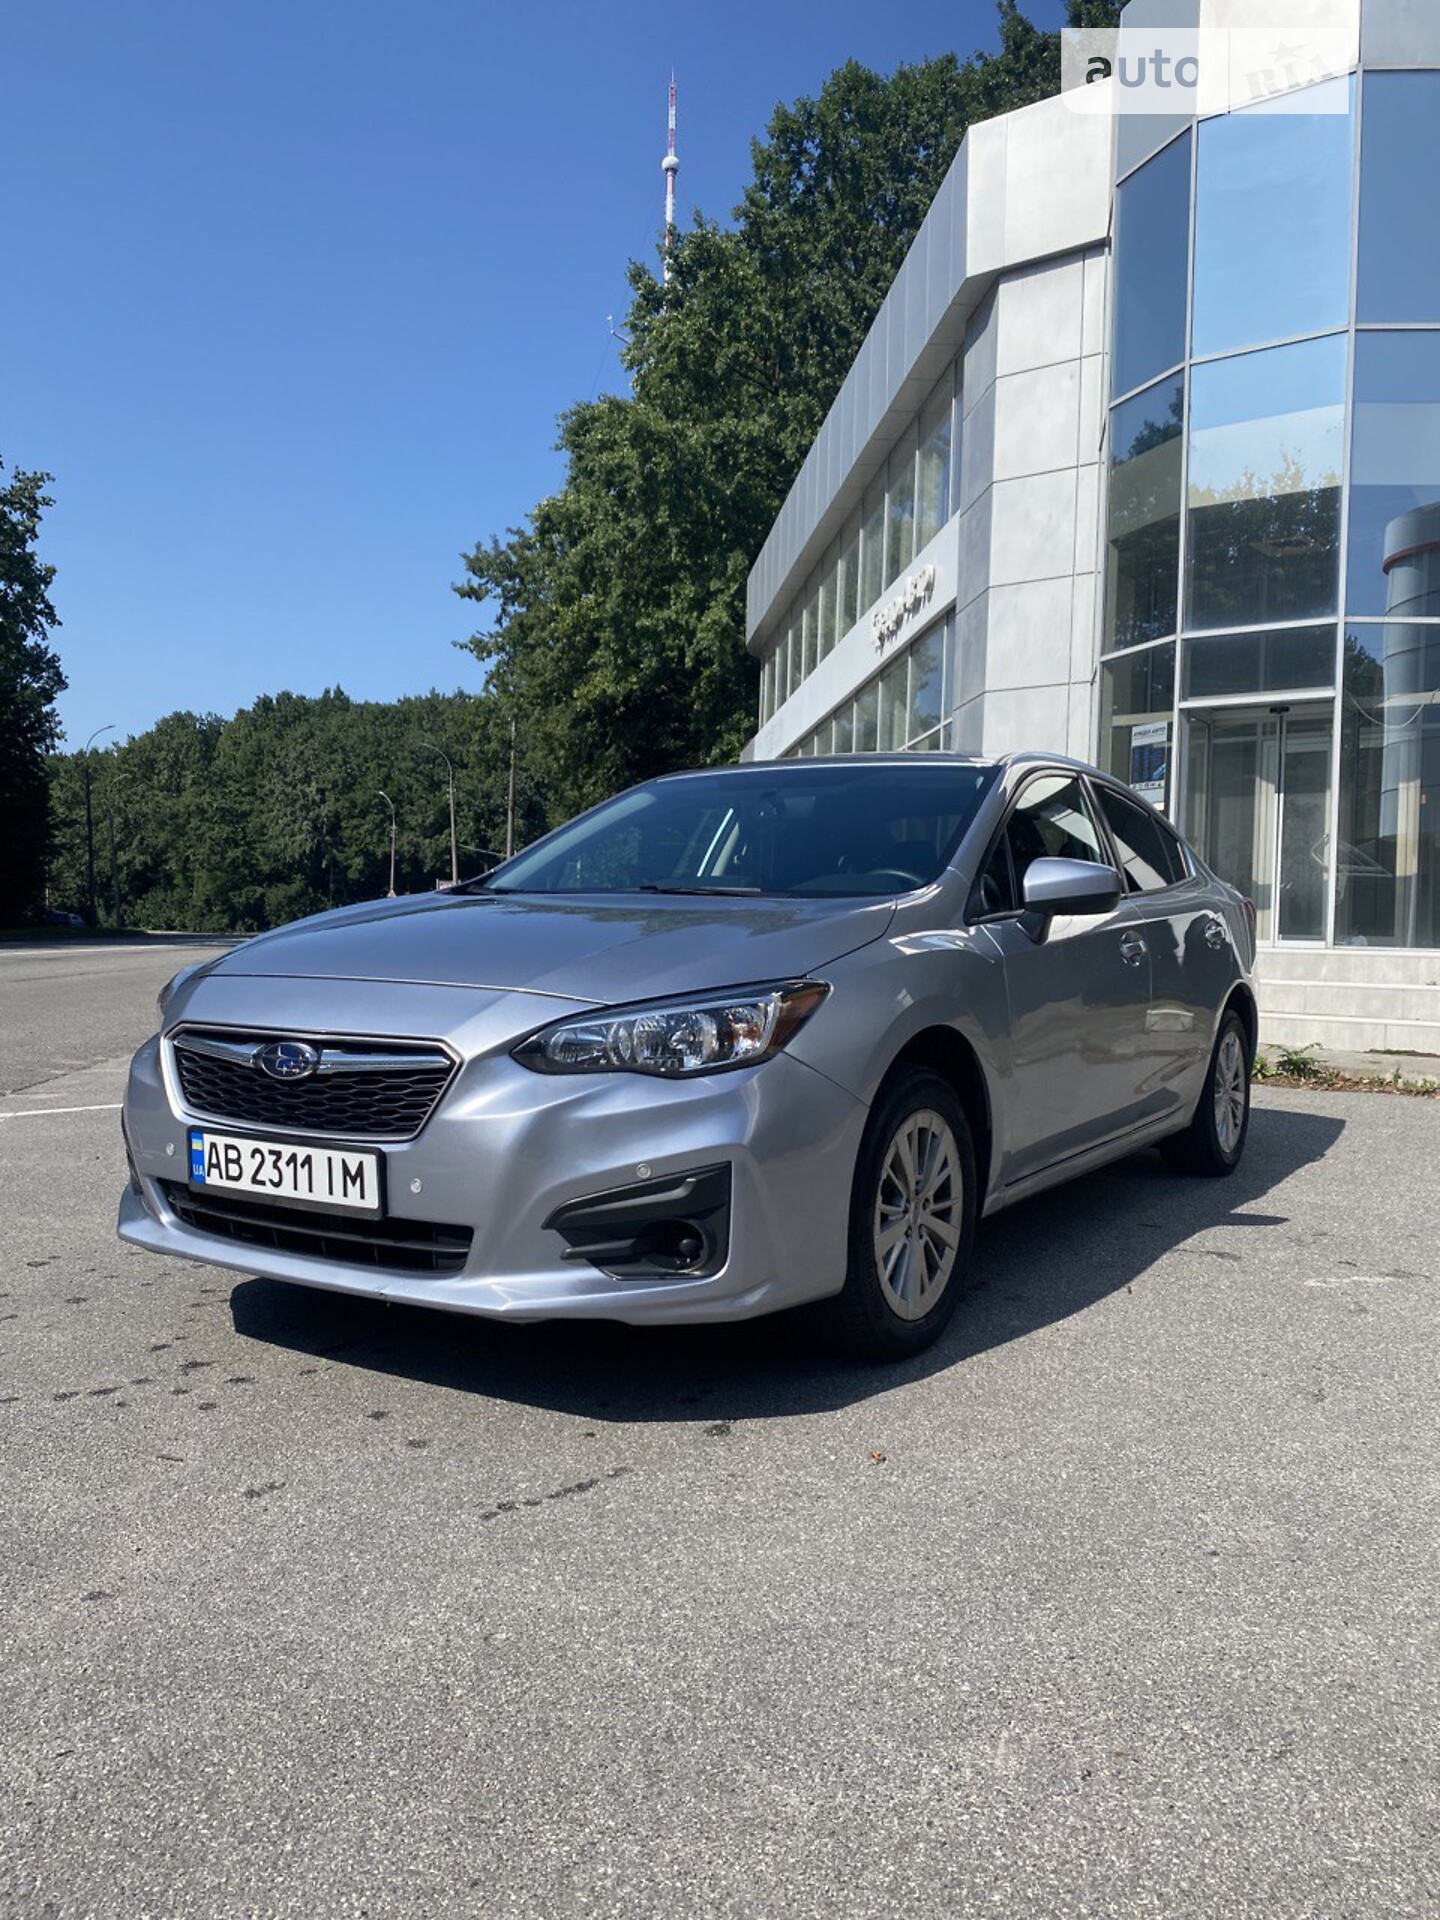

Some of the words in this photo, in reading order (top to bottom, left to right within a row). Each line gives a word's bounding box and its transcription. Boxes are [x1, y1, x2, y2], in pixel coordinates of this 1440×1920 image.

[193, 1163, 204, 1176] UA
[207, 1141, 243, 1182] AB
[251, 1148, 313, 1193] 2311
[328, 1156, 366, 1200] IM
